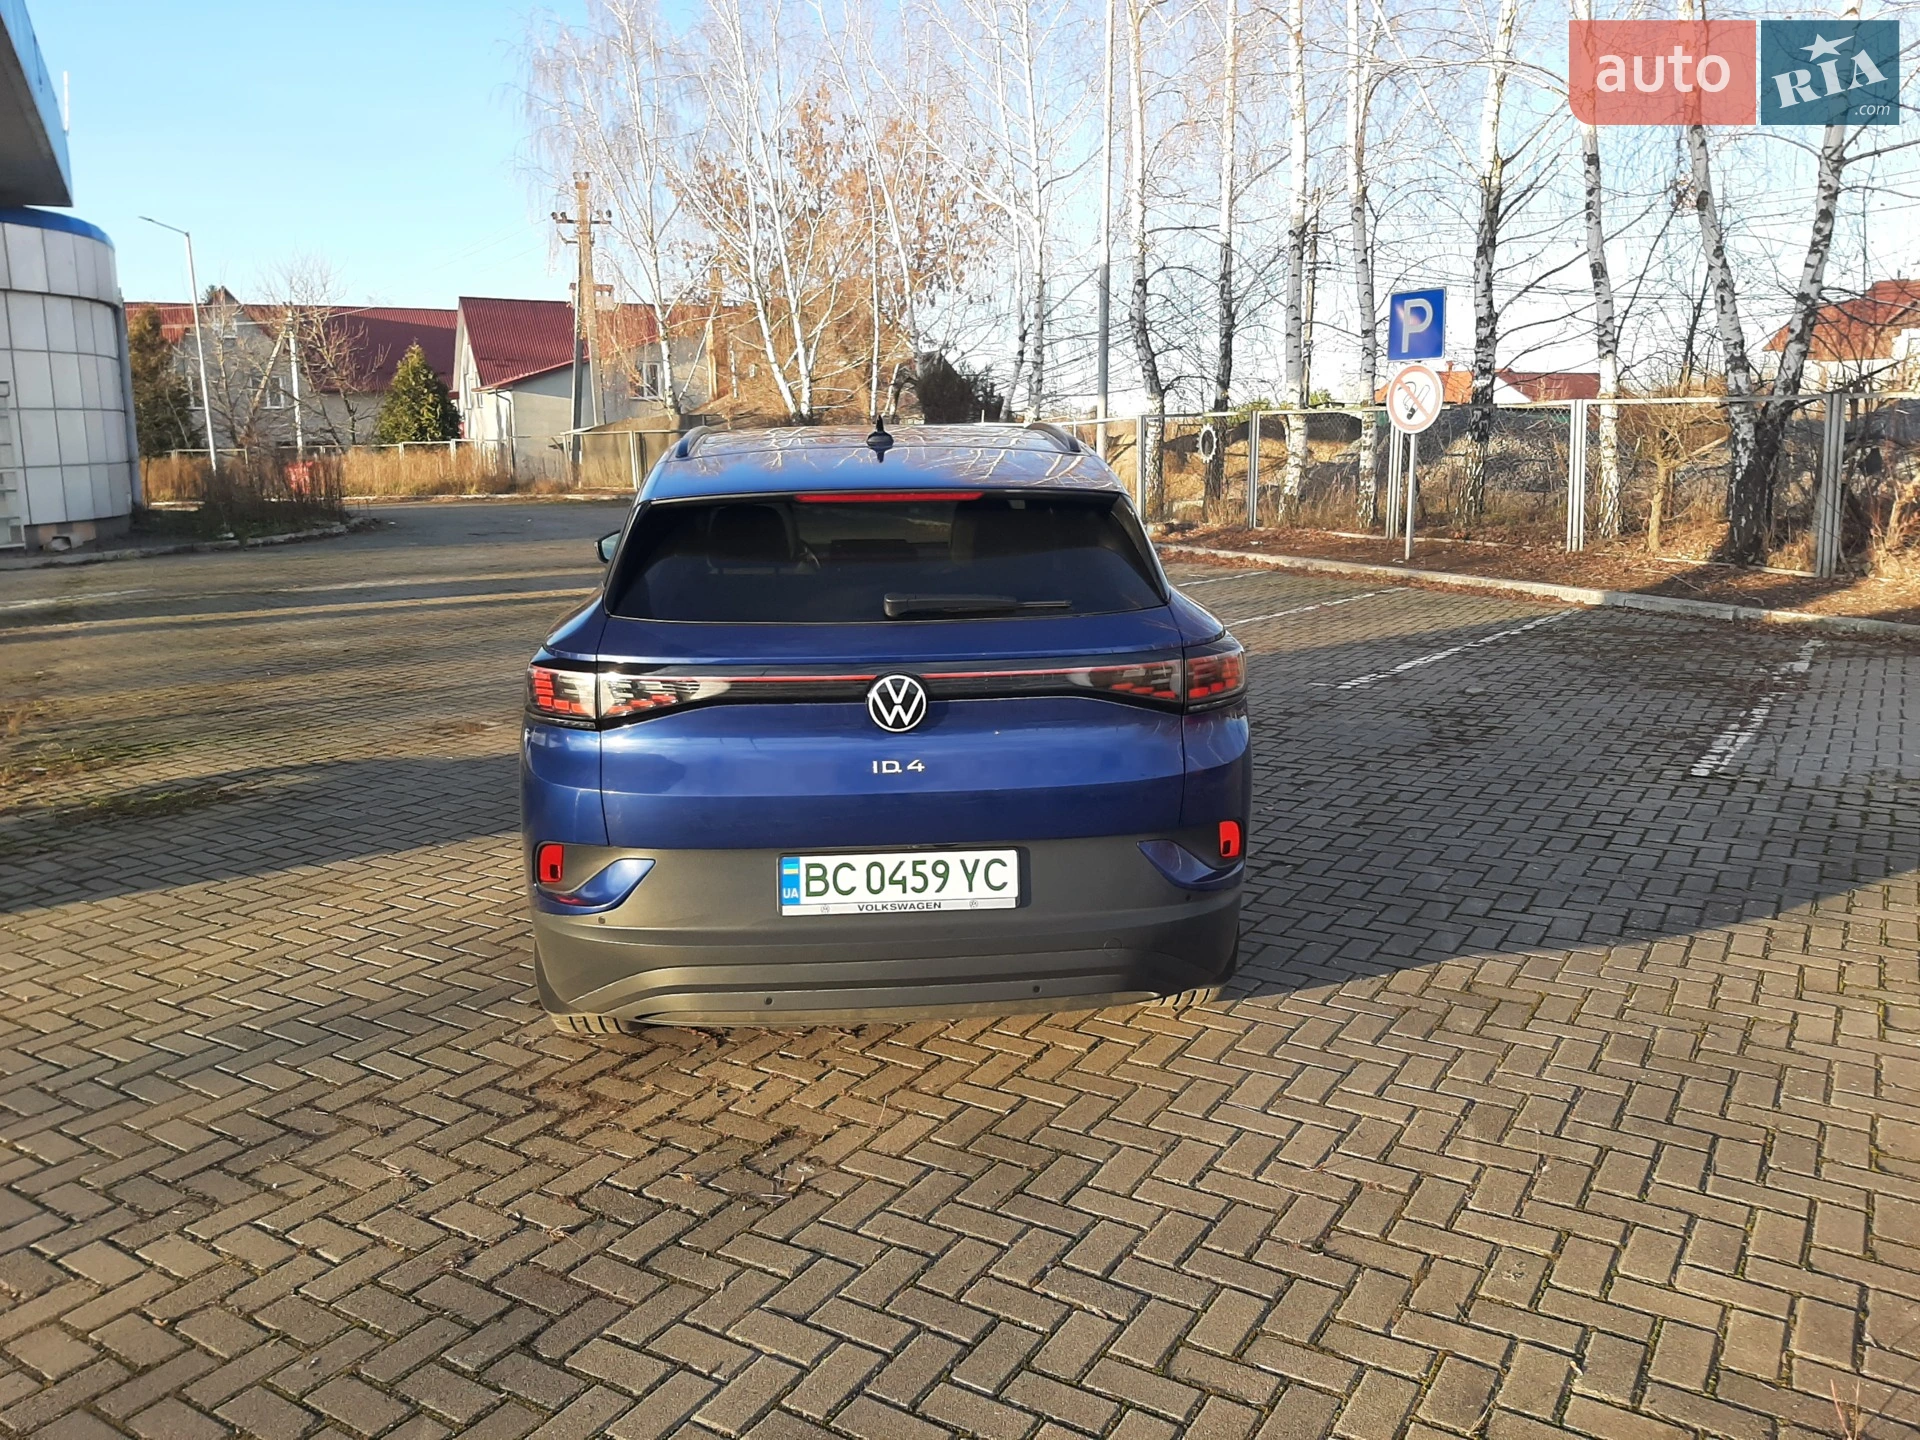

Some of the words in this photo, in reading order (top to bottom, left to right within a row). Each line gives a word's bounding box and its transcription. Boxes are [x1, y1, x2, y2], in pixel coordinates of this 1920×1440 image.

[1401, 298, 1433, 353] P
[805, 862, 857, 897] BC
[866, 859, 950, 894] 0459
[959, 858, 1008, 893] YC
[783, 887, 799, 899] UA
[857, 901, 942, 912] VOLKSWAGEN
